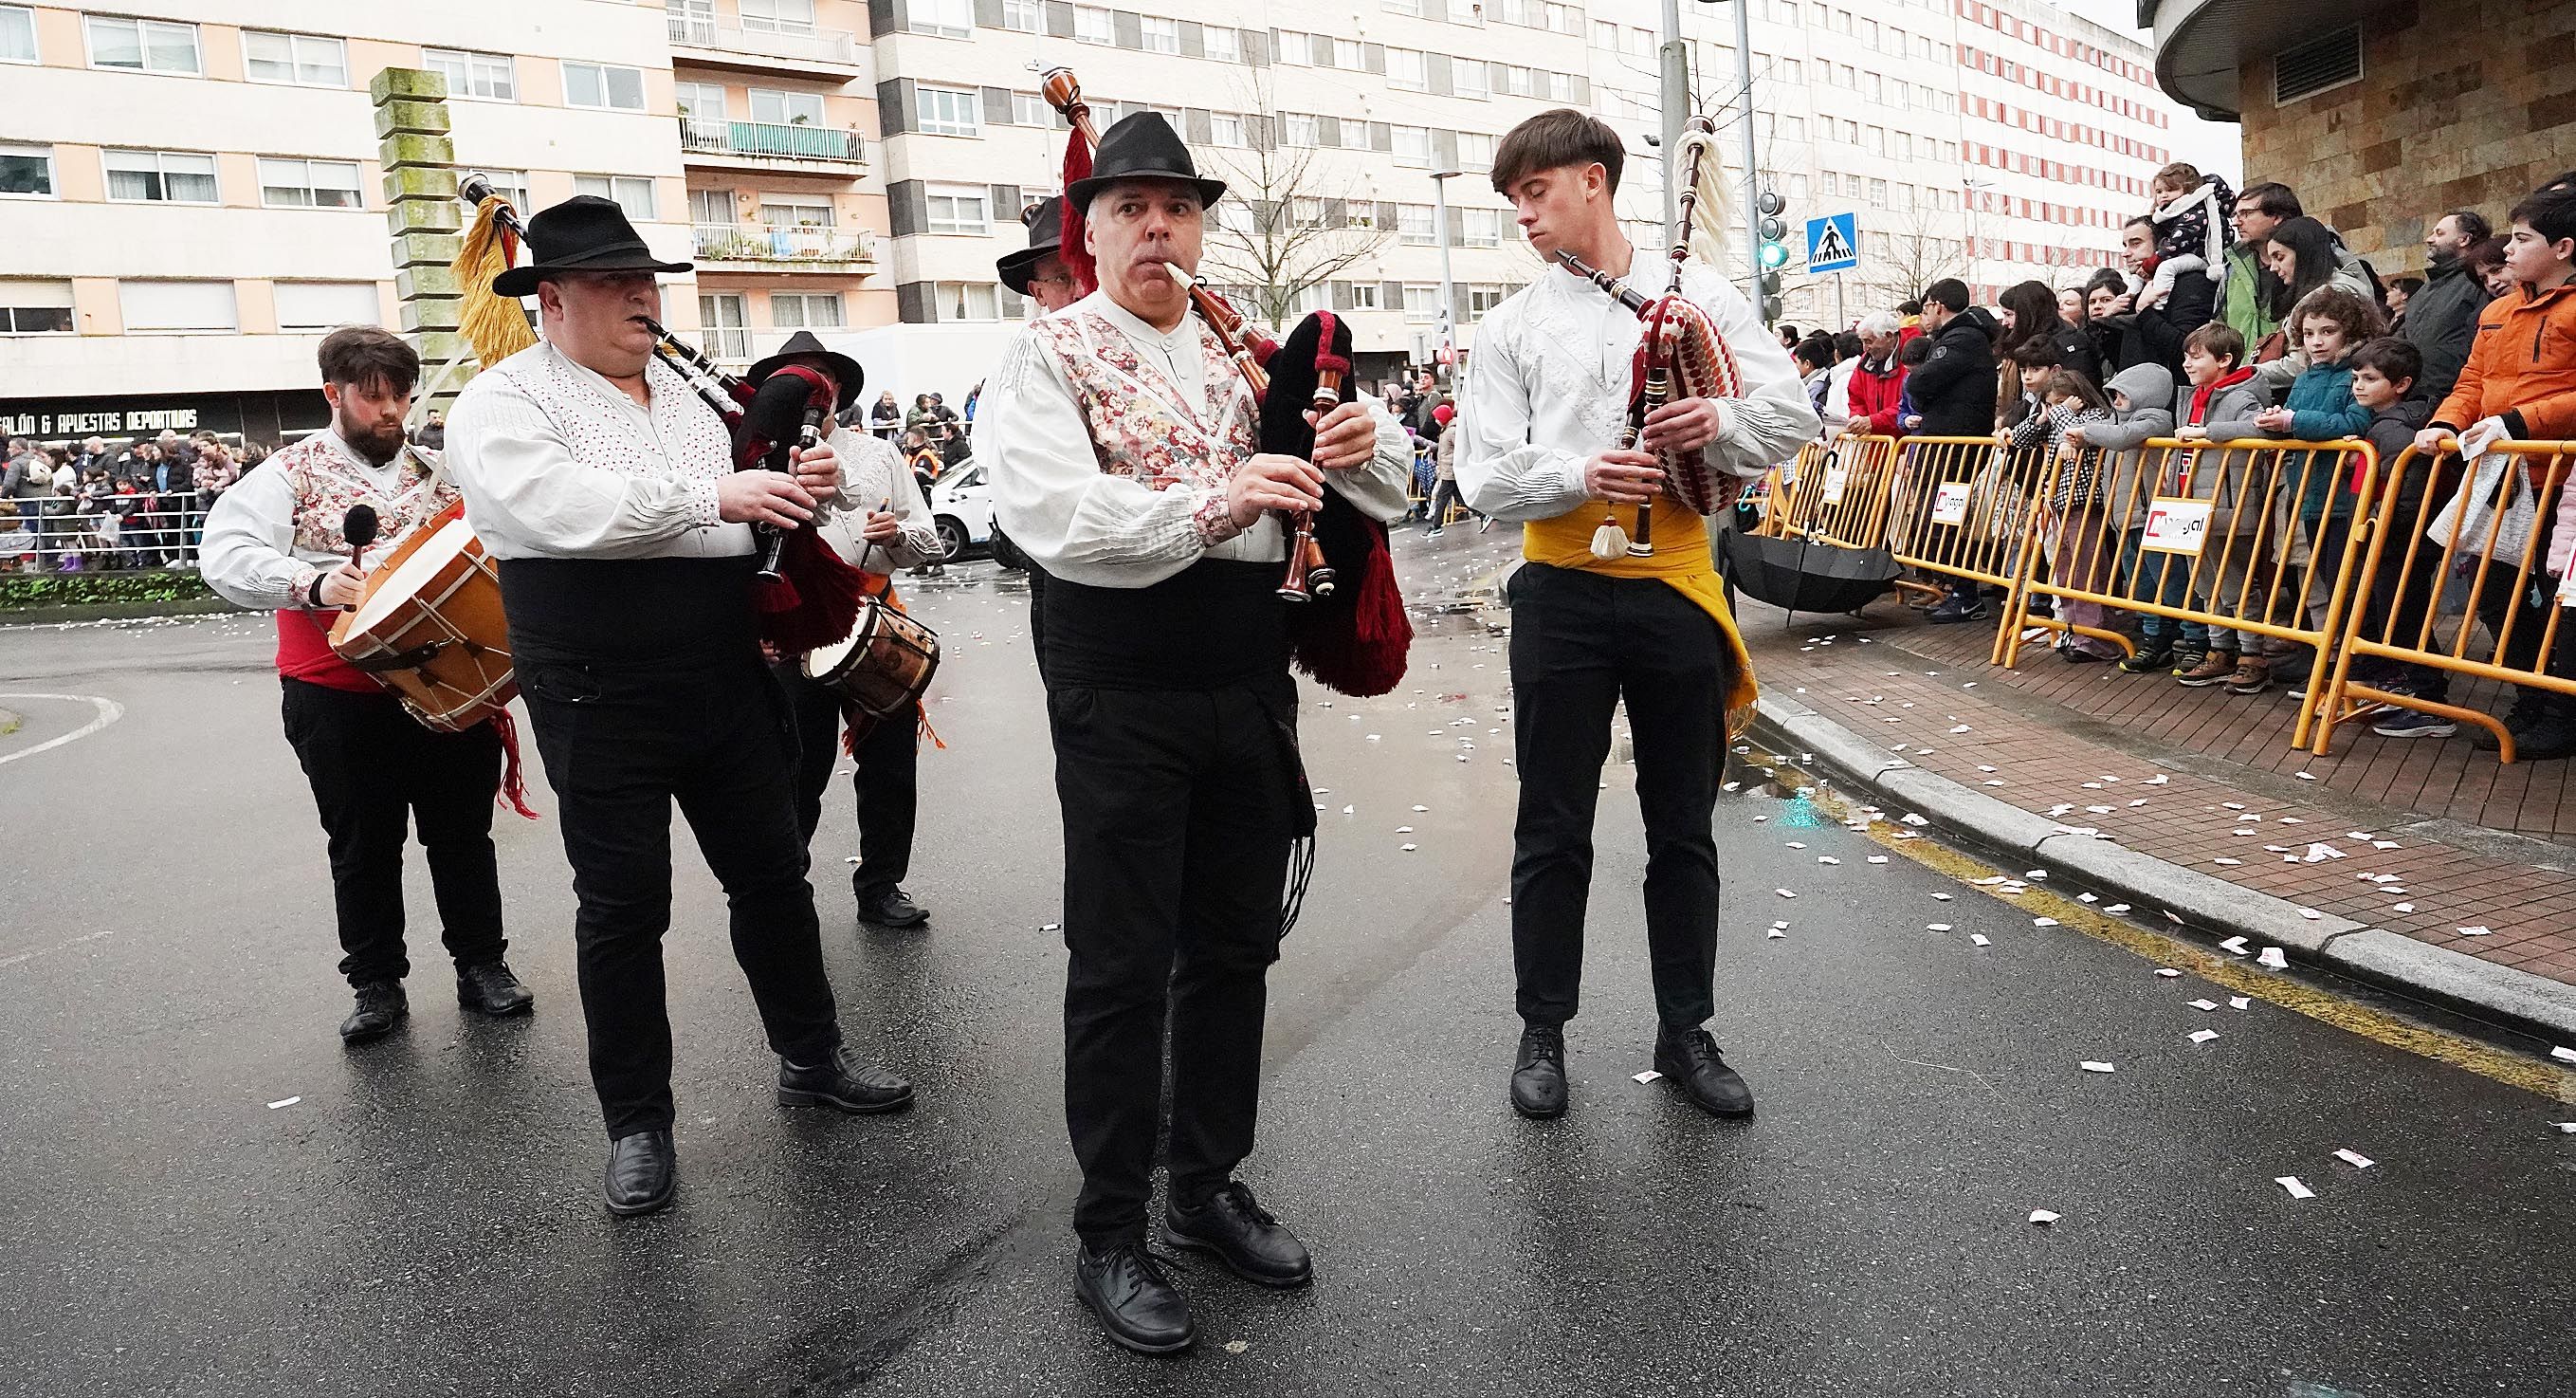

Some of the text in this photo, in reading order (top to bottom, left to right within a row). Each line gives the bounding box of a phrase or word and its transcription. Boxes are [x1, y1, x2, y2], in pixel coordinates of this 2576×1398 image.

[42, 415, 51, 434] &
[58, 413, 121, 433] APUESTAS
[126, 409, 198, 431] DEPORTIVAS
